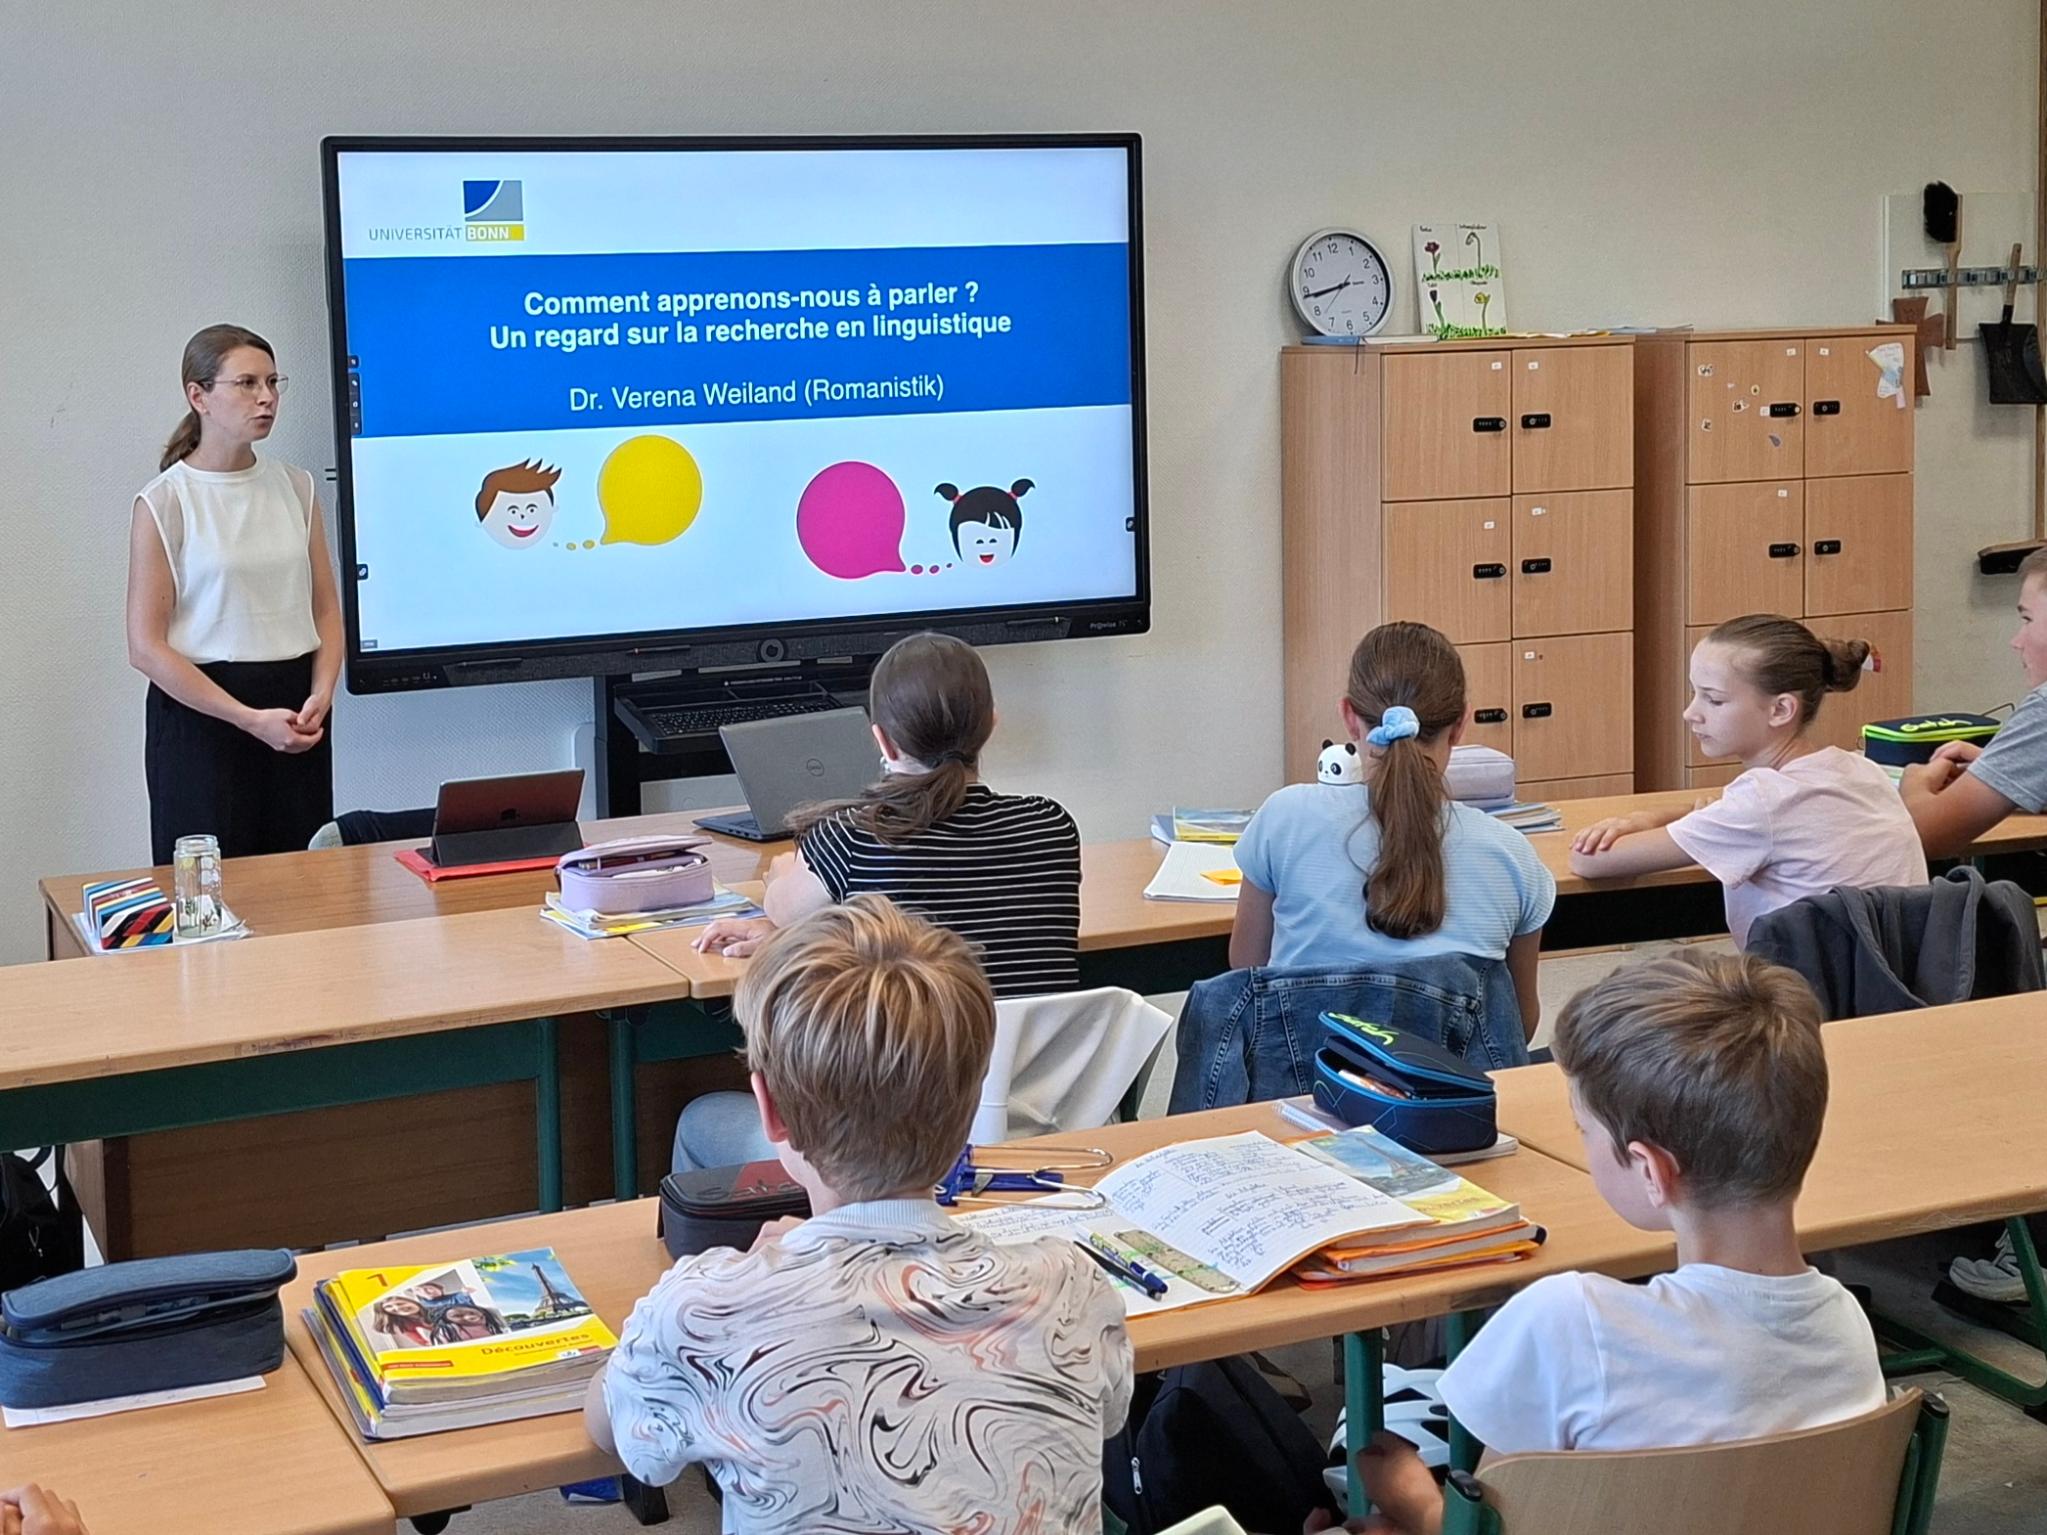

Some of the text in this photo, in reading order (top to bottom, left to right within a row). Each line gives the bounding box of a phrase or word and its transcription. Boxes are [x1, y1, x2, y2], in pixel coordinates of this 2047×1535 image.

[368, 225, 510, 241] UNIVERSITÄT BONN
[1327, 243, 1339, 255] 12
[1349, 246, 1354, 257] 1
[1312, 251, 1323, 261] 11
[1362, 258, 1371, 269] 2
[1304, 267, 1315, 278] 10
[1371, 274, 1380, 285] 3
[1303, 286, 1311, 297] 9
[524, 281, 979, 318] Comment apprenons-nous à parler ?
[1372, 296, 1379, 306] 4
[1314, 305, 1321, 316] 8
[1363, 311, 1370, 322] 5
[1328, 317, 1335, 328] 7
[1346, 319, 1353, 330] 6
[490, 312, 1011, 353] Un regard sur la recherche en linguistique
[570, 374, 944, 411] Dr. Verena Weiland (Romanistik)
[480, 1332, 590, 1356] Découvertes
